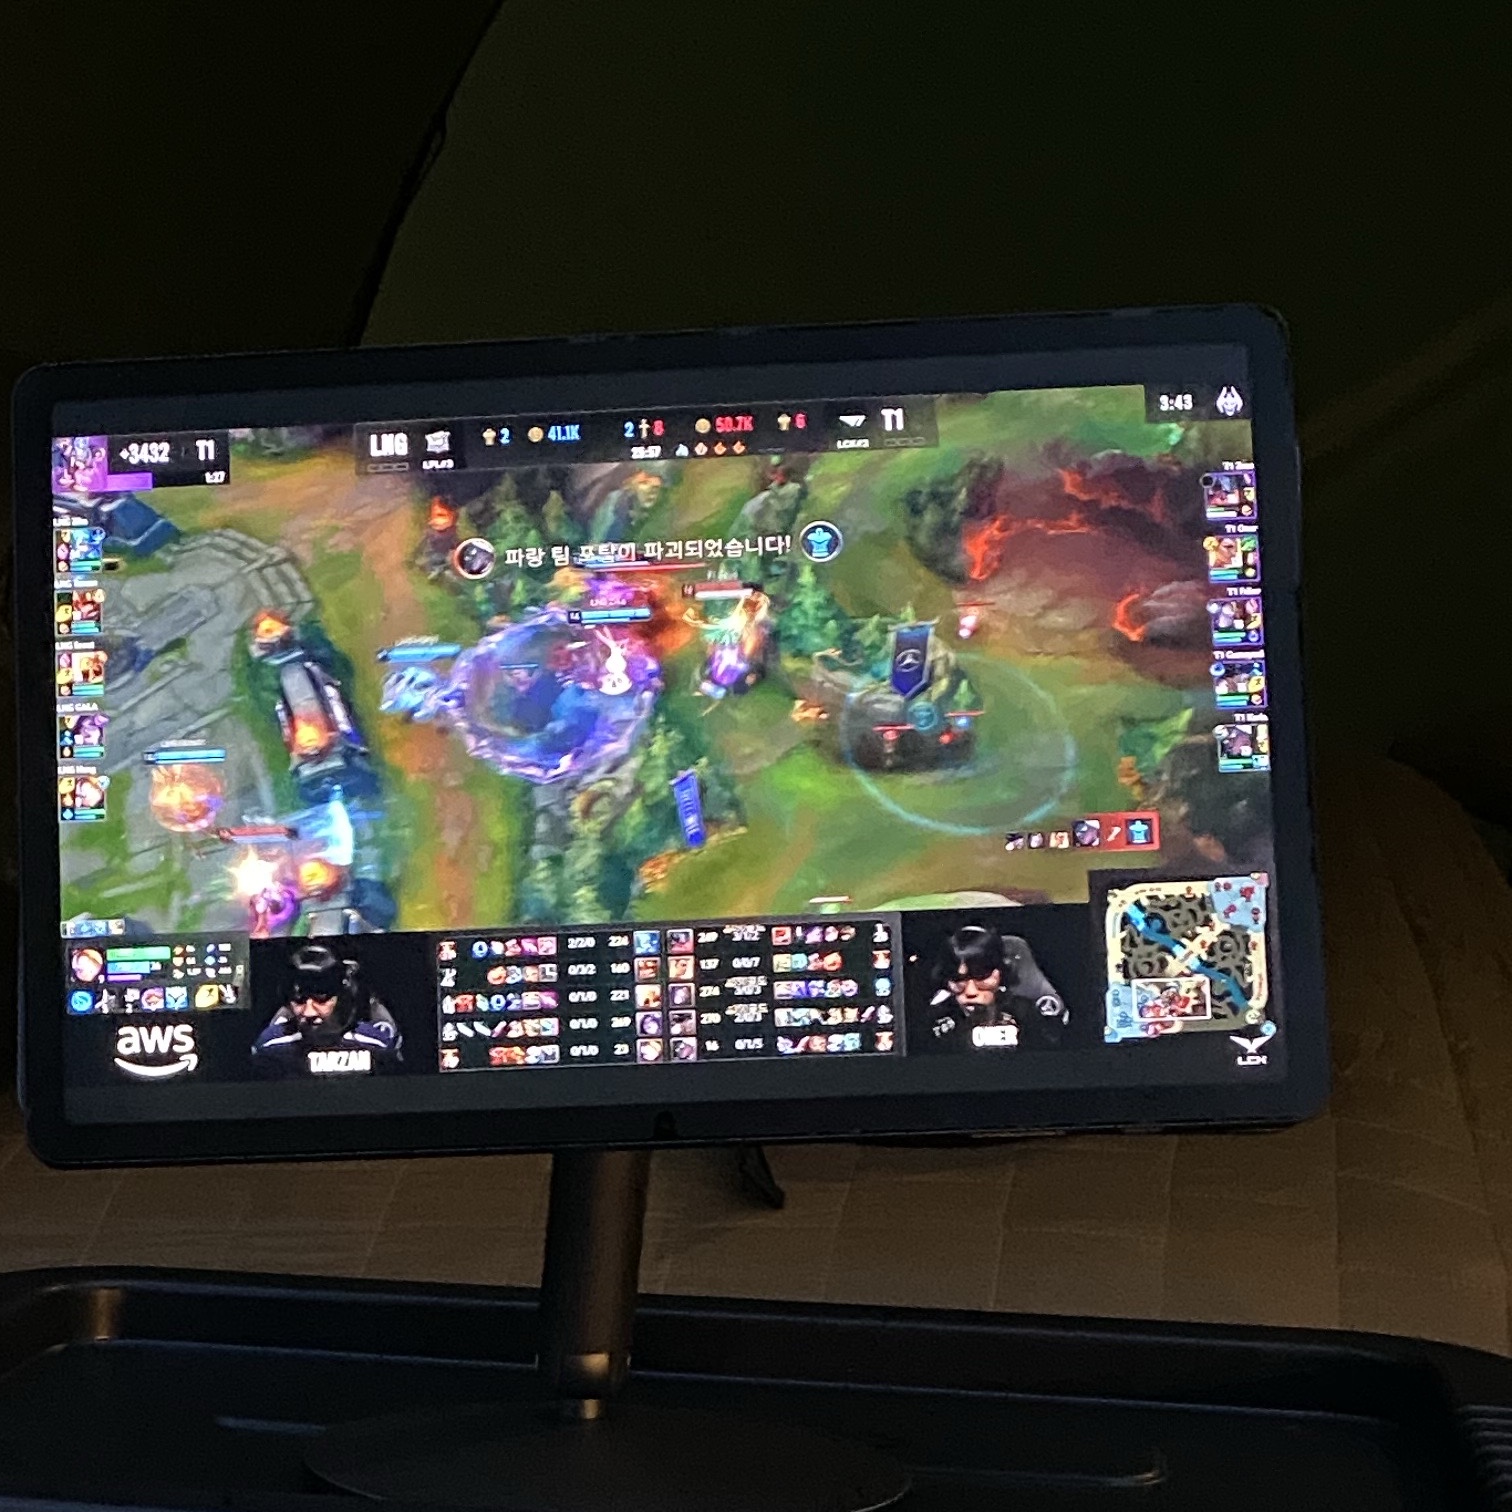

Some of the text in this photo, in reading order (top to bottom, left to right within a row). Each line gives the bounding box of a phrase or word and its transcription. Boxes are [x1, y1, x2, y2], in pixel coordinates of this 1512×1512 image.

[880, 407, 904, 432] T1
[195, 439, 215, 461] T1
[505, 547, 546, 568] 파랑
[551, 545, 570, 567] 팀
[644, 535, 791, 560] 파괴되었습니다!
[116, 1024, 197, 1057] aws
